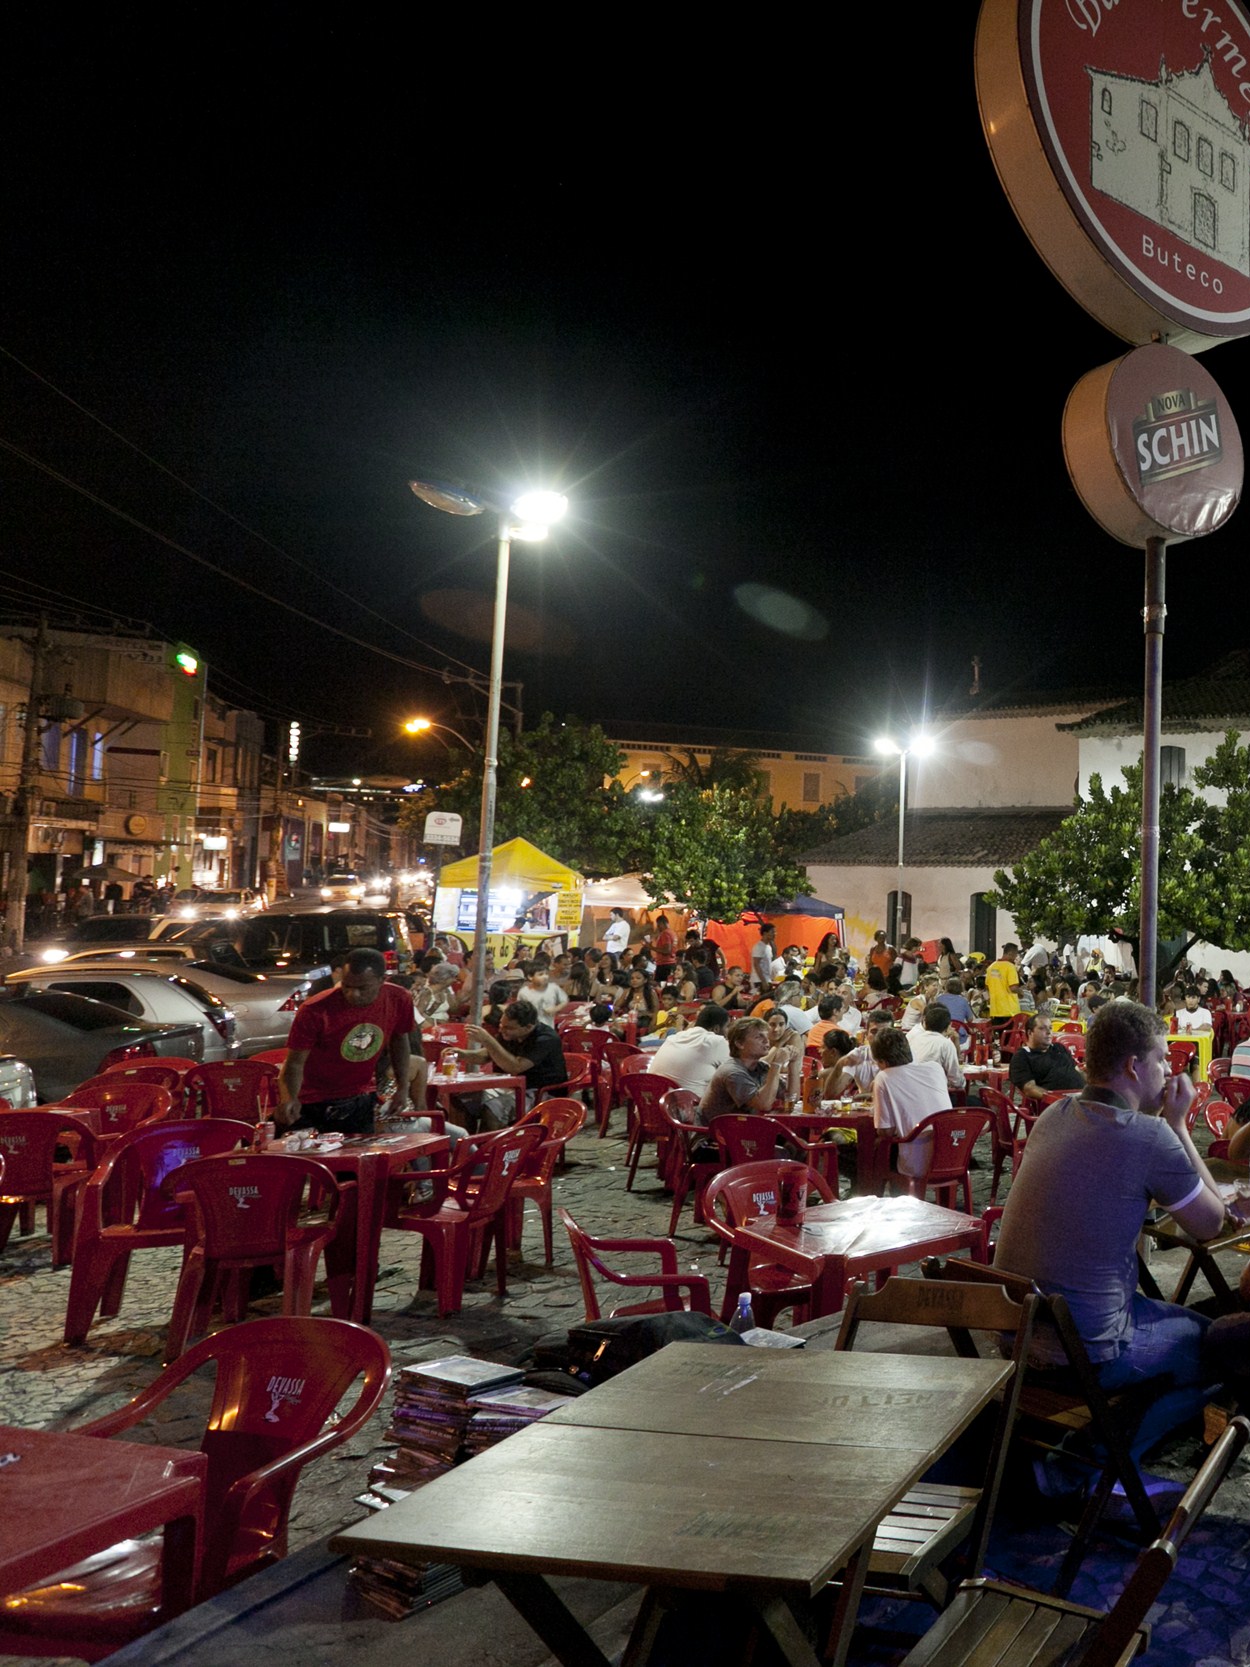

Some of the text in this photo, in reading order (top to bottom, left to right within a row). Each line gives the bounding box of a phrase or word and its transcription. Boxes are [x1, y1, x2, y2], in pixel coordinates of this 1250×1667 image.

[1142, 234, 1224, 295] Buteco
[1157, 393, 1186, 411] NOVA
[1137, 414, 1220, 471] SCHIN
[229, 1186, 259, 1196] DEVASSA
[752, 1191, 775, 1202] DEVASSA
[266, 1376, 305, 1395] DEVASSA
